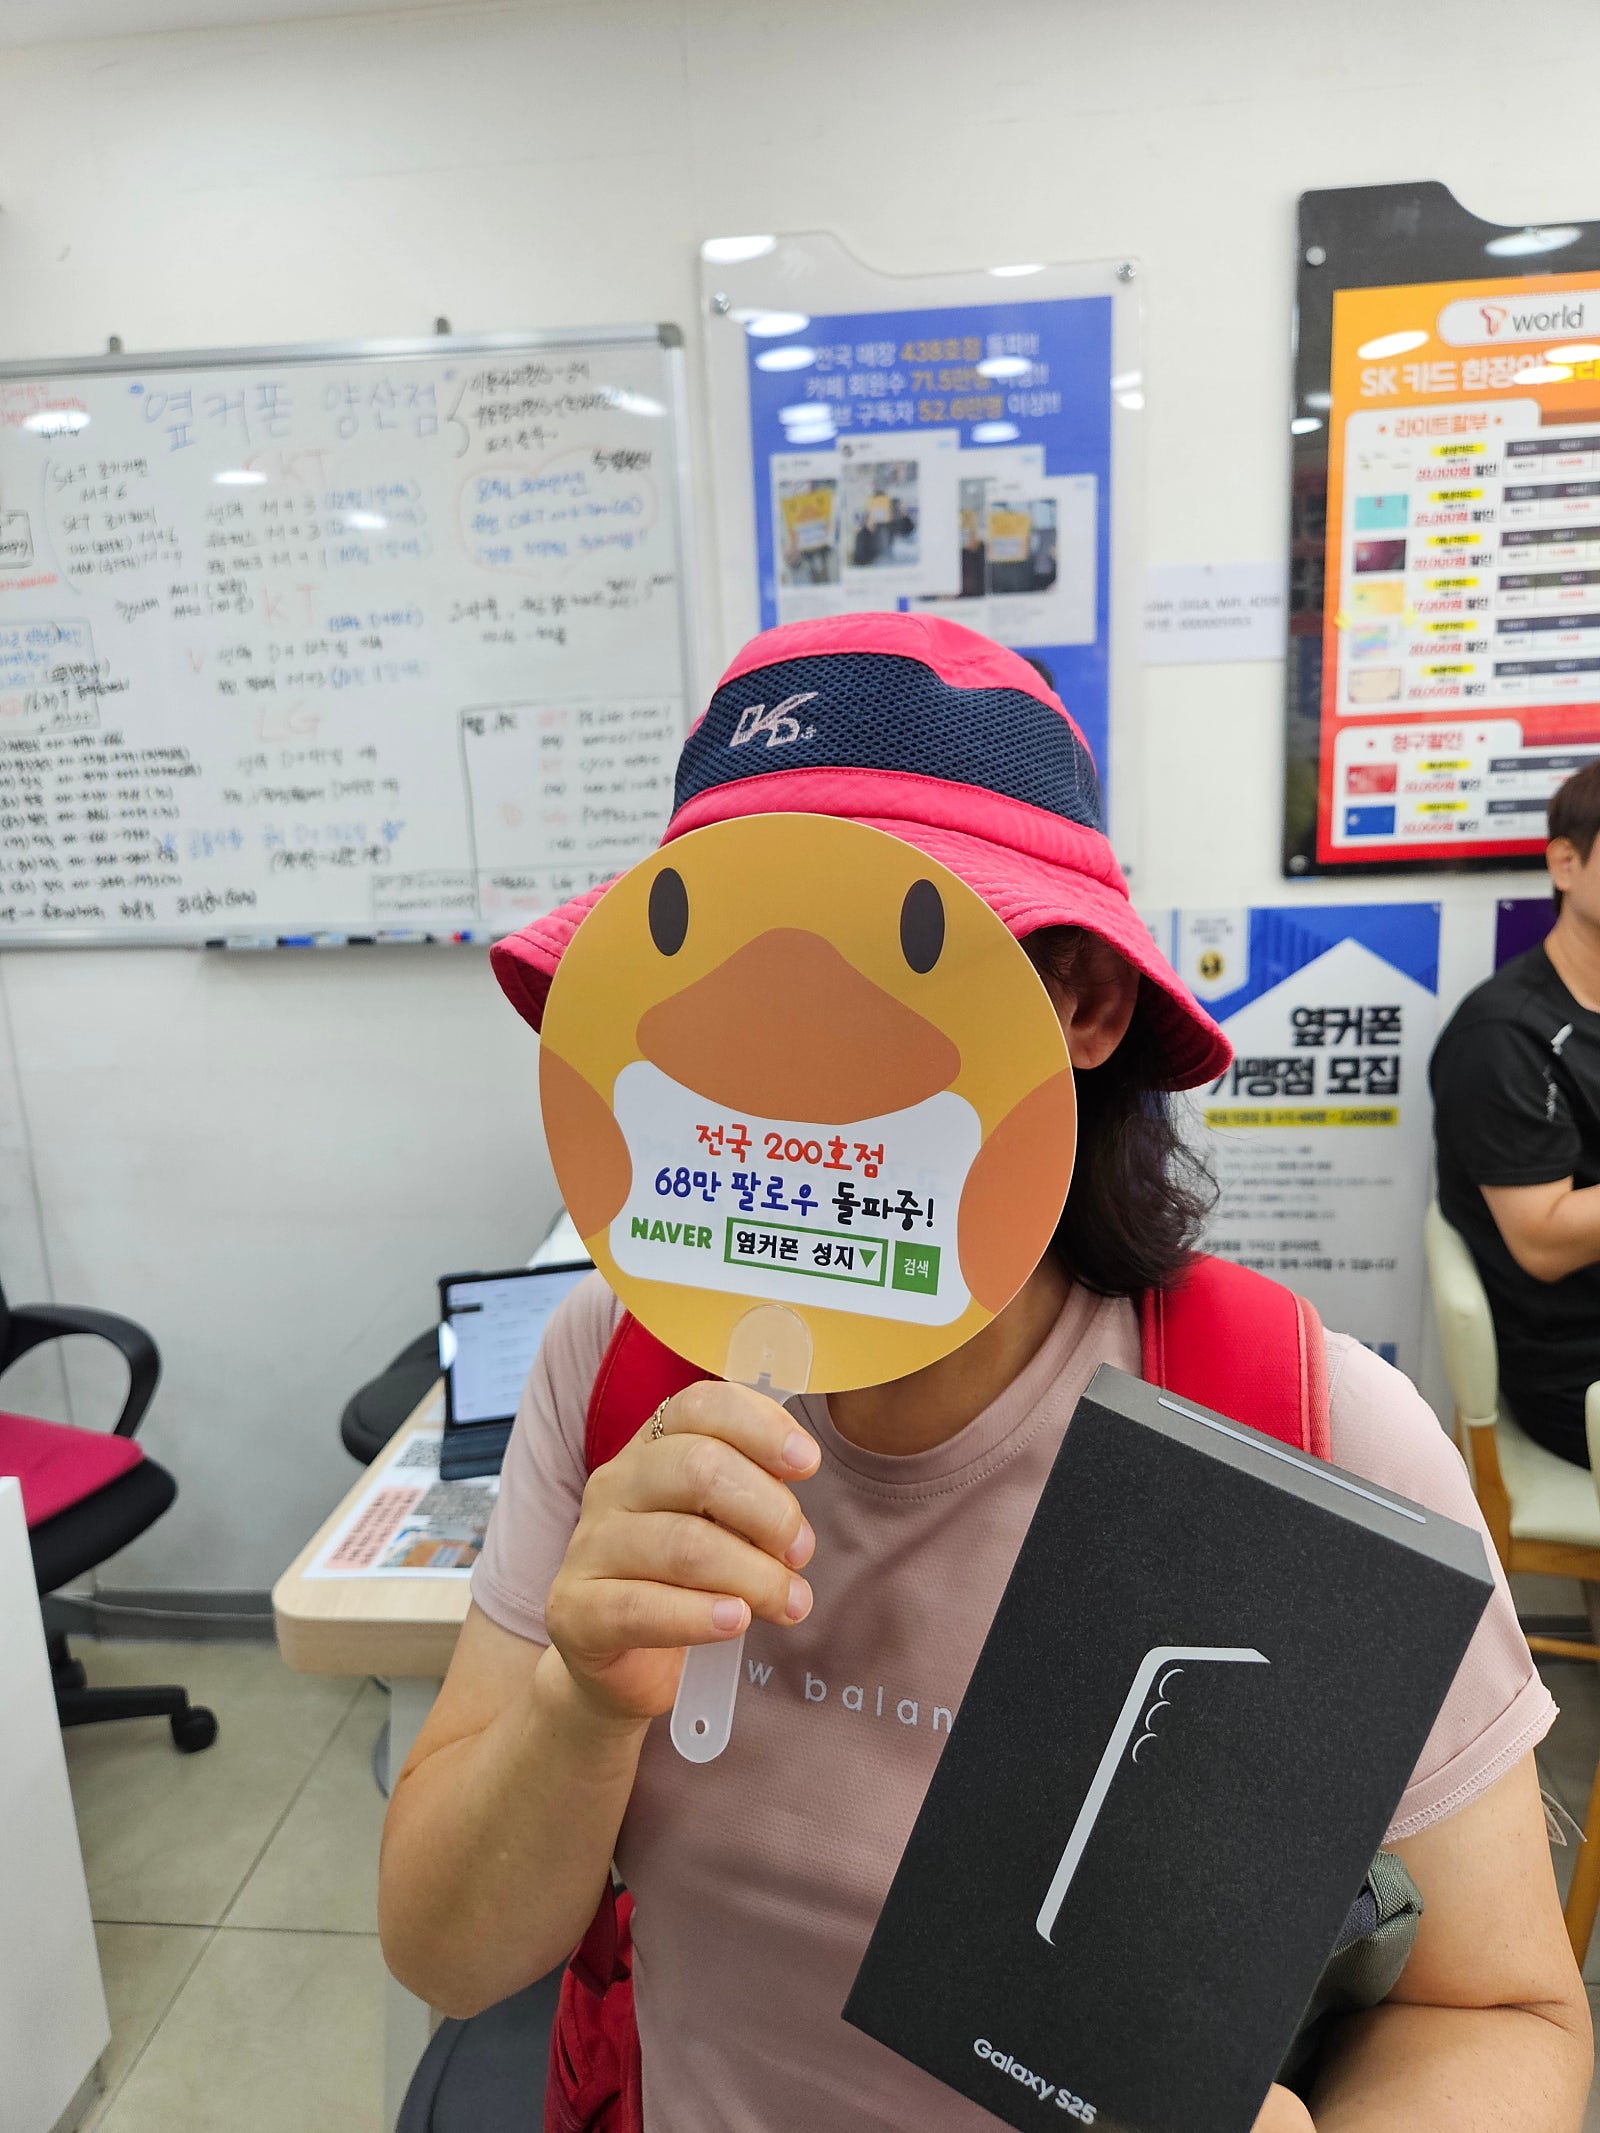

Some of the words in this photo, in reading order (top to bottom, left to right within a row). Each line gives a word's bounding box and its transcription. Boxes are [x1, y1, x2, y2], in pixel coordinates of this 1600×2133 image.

[1512, 303, 1584, 332] world
[1360, 366, 1398, 397] SK
[1403, 360, 1458, 394] 카드
[145, 381, 293, 452] 옆커폰
[325, 380, 439, 440] 양산점
[1291, 1005, 1402, 1047] 옆커폰
[1209, 1056, 1315, 1098] 가맹점
[1326, 1054, 1400, 1097] 모집
[696, 1123, 753, 1164] 전국
[763, 1131, 885, 1179] 200호점
[655, 1166, 722, 1203] 68만
[730, 1171, 819, 1217] 팔로우
[831, 1181, 935, 1231] 돌파중!
[631, 1216, 713, 1250] NAVER
[736, 1230, 799, 1262] 옆커폰
[812, 1241, 854, 1271] 성지
[903, 1257, 930, 1279] 검색
[804, 1672, 953, 1734] balan
[973, 2038, 1056, 2101] Galaxy
[1055, 2088, 1098, 2125] S25
